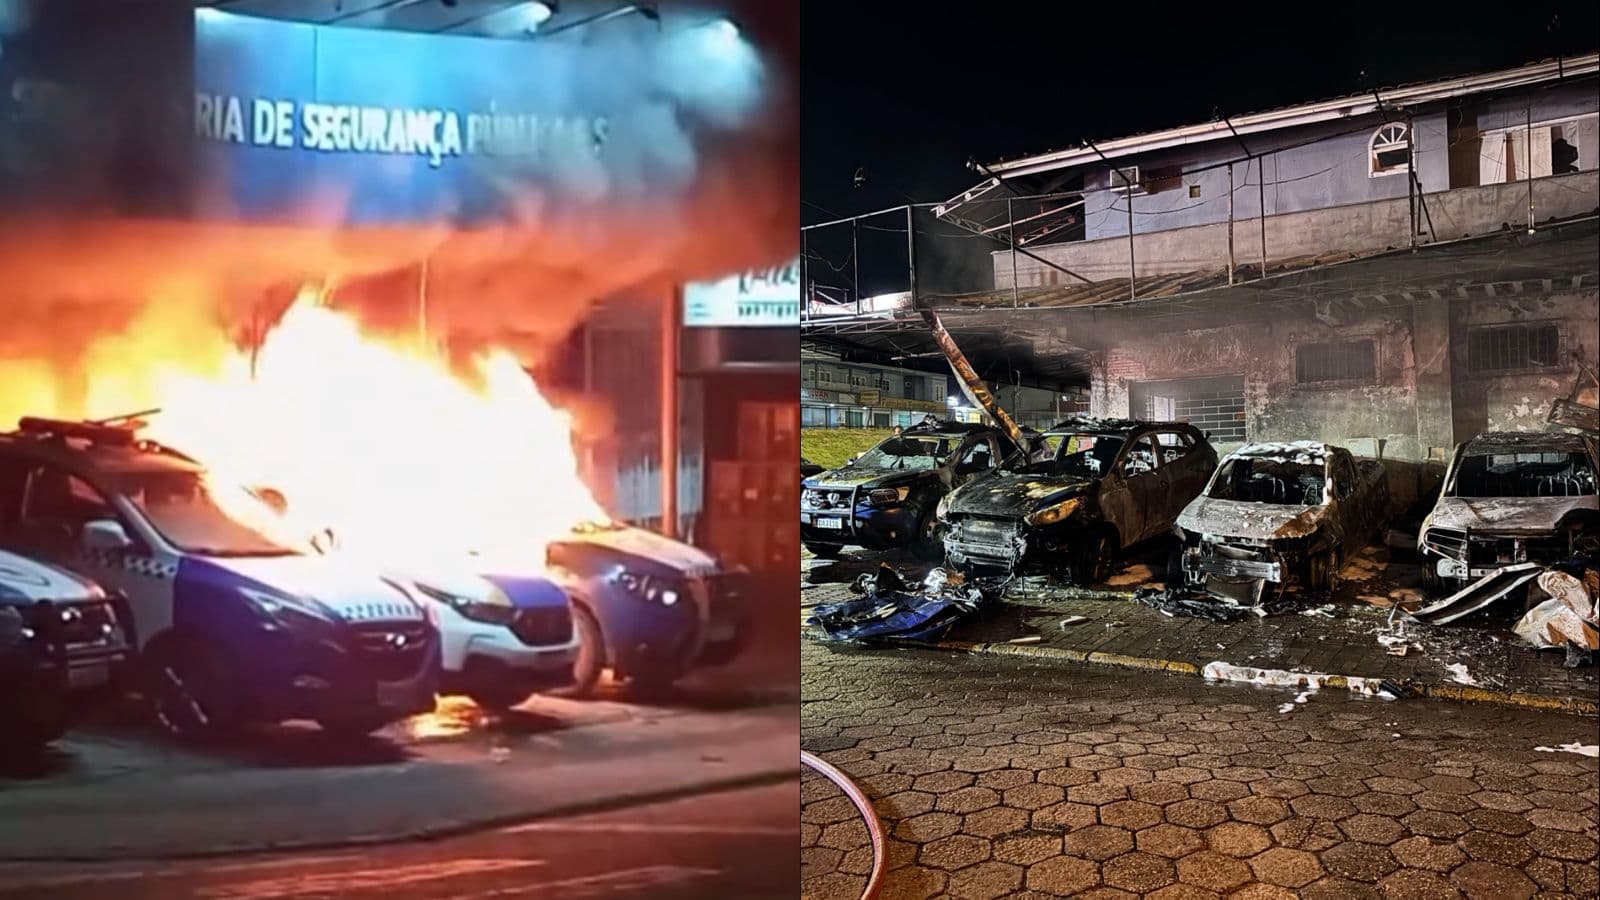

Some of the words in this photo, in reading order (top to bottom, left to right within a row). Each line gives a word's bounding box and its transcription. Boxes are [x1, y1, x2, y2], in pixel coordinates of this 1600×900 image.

[195, 94, 246, 143] RIA
[253, 99, 294, 147] DE
[303, 104, 461, 168] SEGURANÇA
